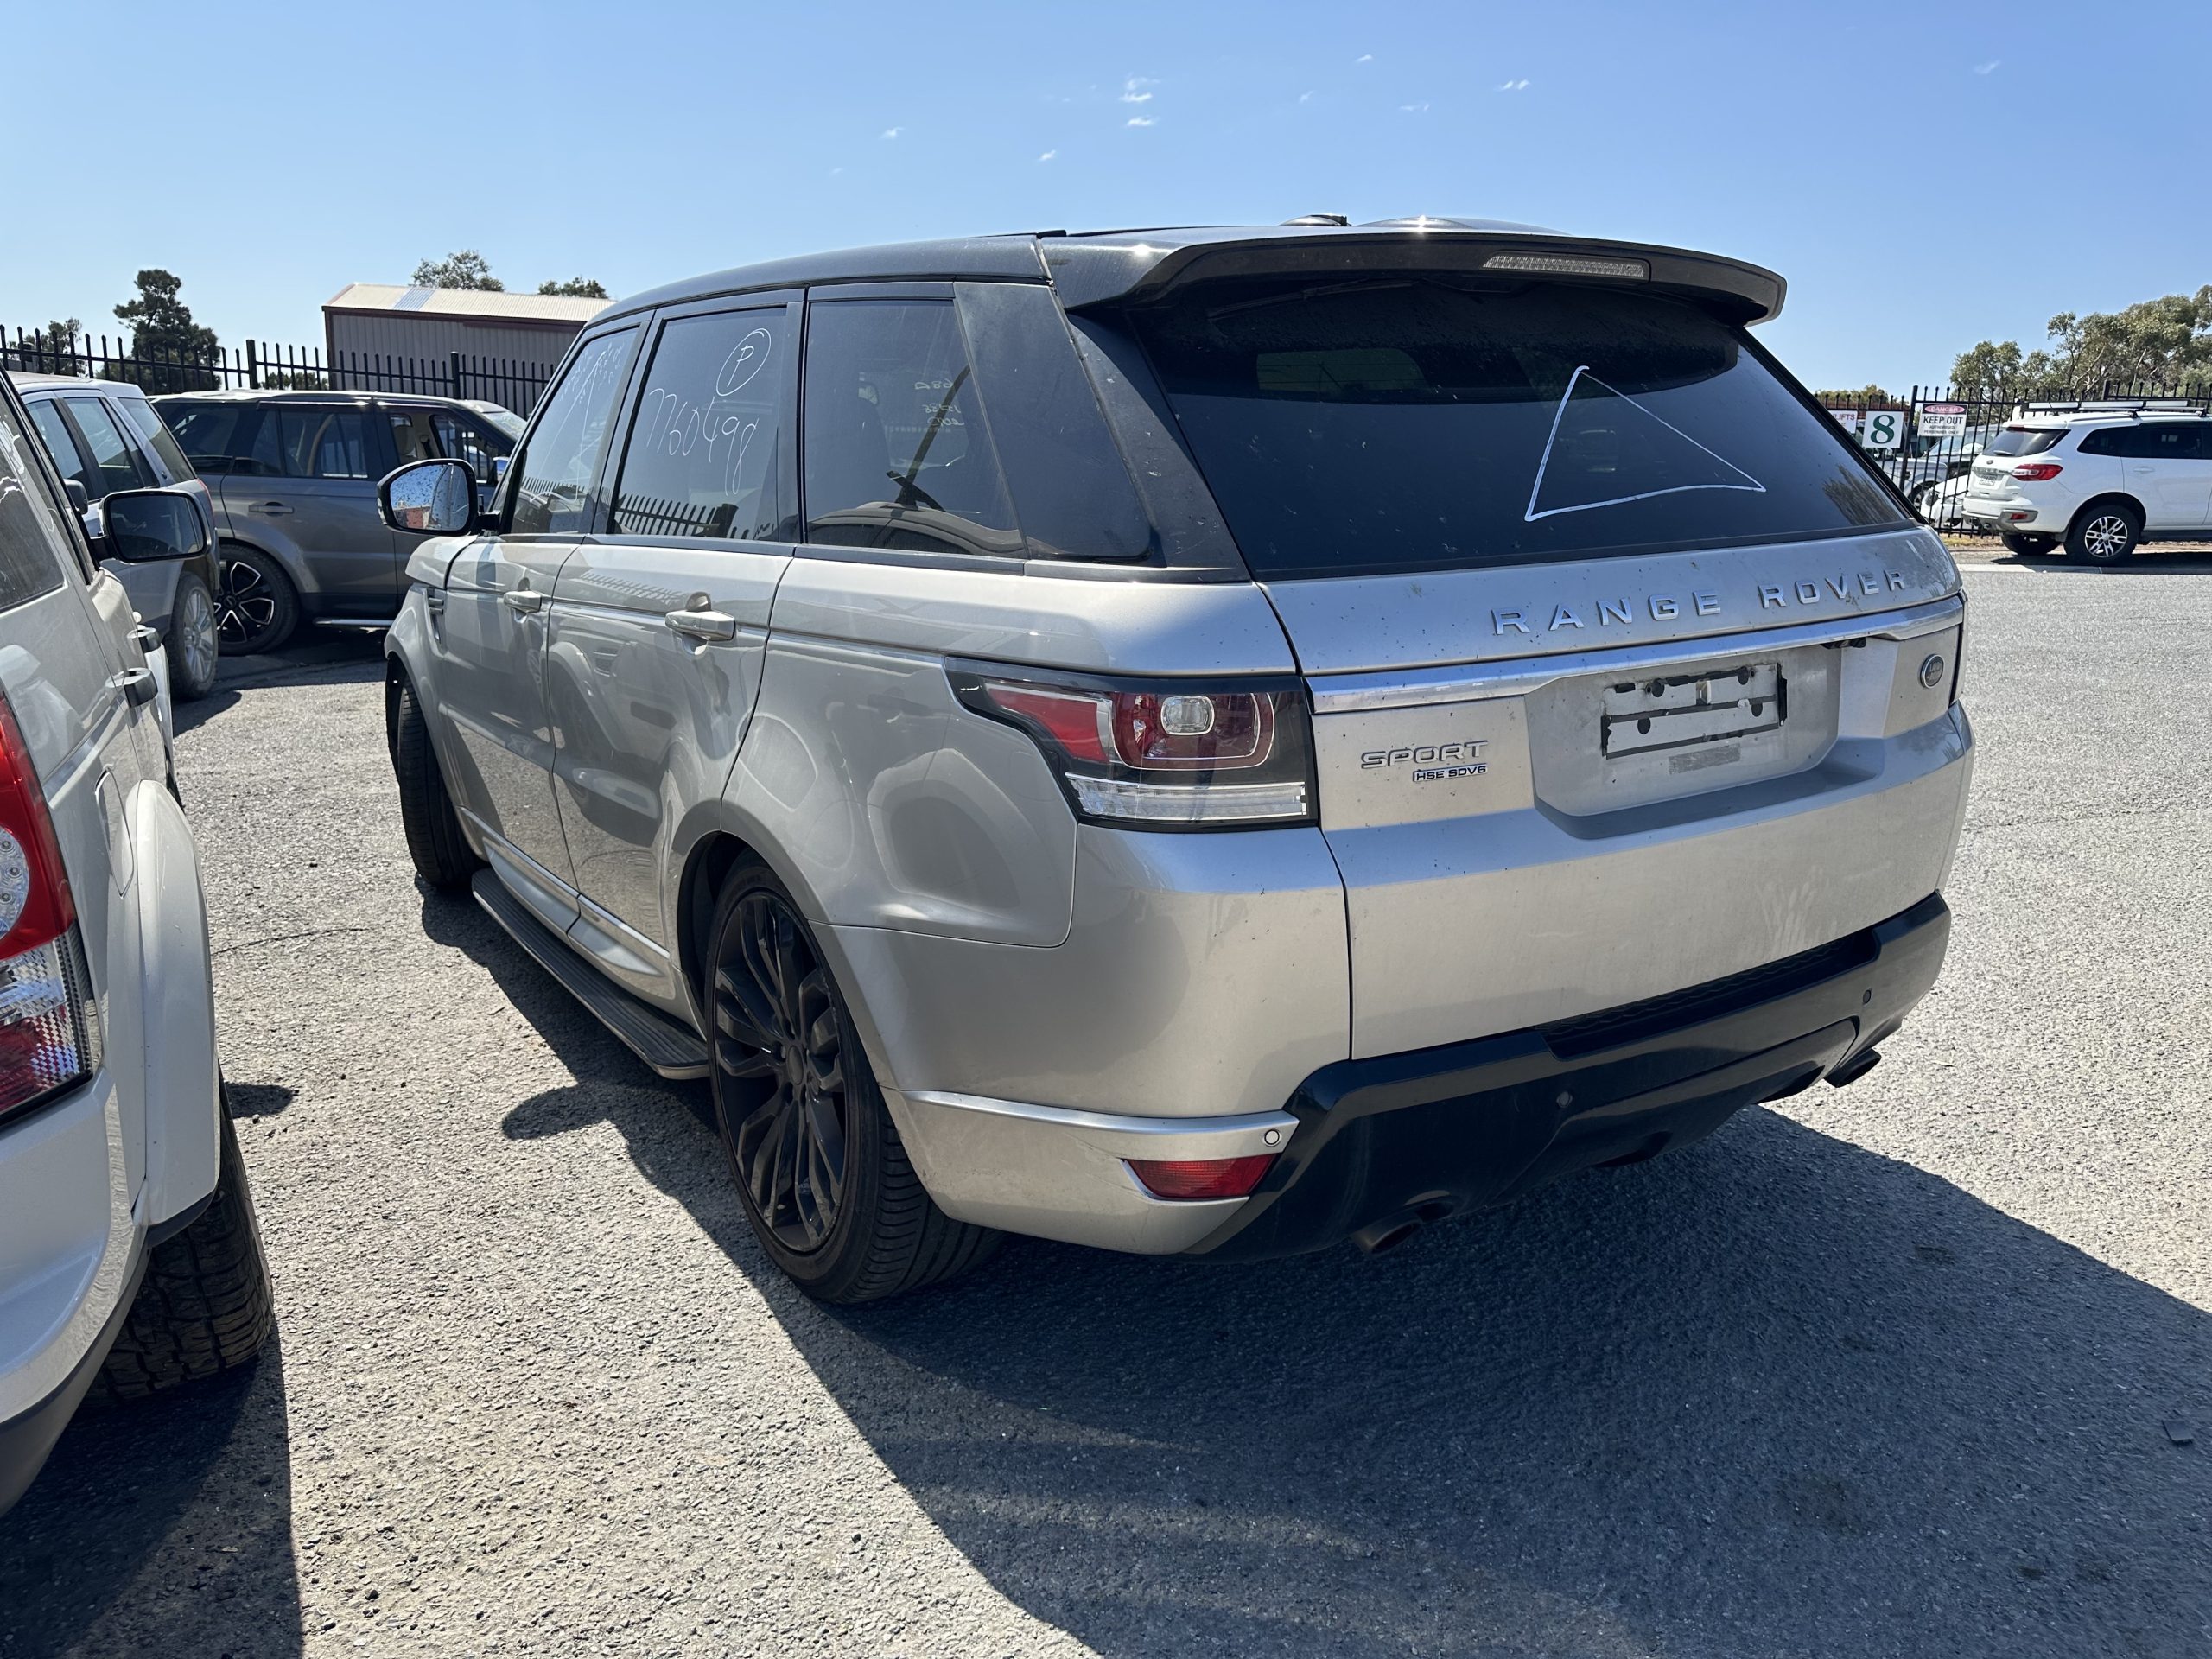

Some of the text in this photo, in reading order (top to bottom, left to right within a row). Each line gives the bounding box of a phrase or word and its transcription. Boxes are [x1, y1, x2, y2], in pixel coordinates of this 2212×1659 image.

[727, 344, 754, 387] P
[1870, 414, 1895, 444] 8
[1491, 569, 1906, 635] RANGE ROVER
[1361, 740, 1489, 769] SPORT
[1416, 766, 1486, 781] HSE SDV6
